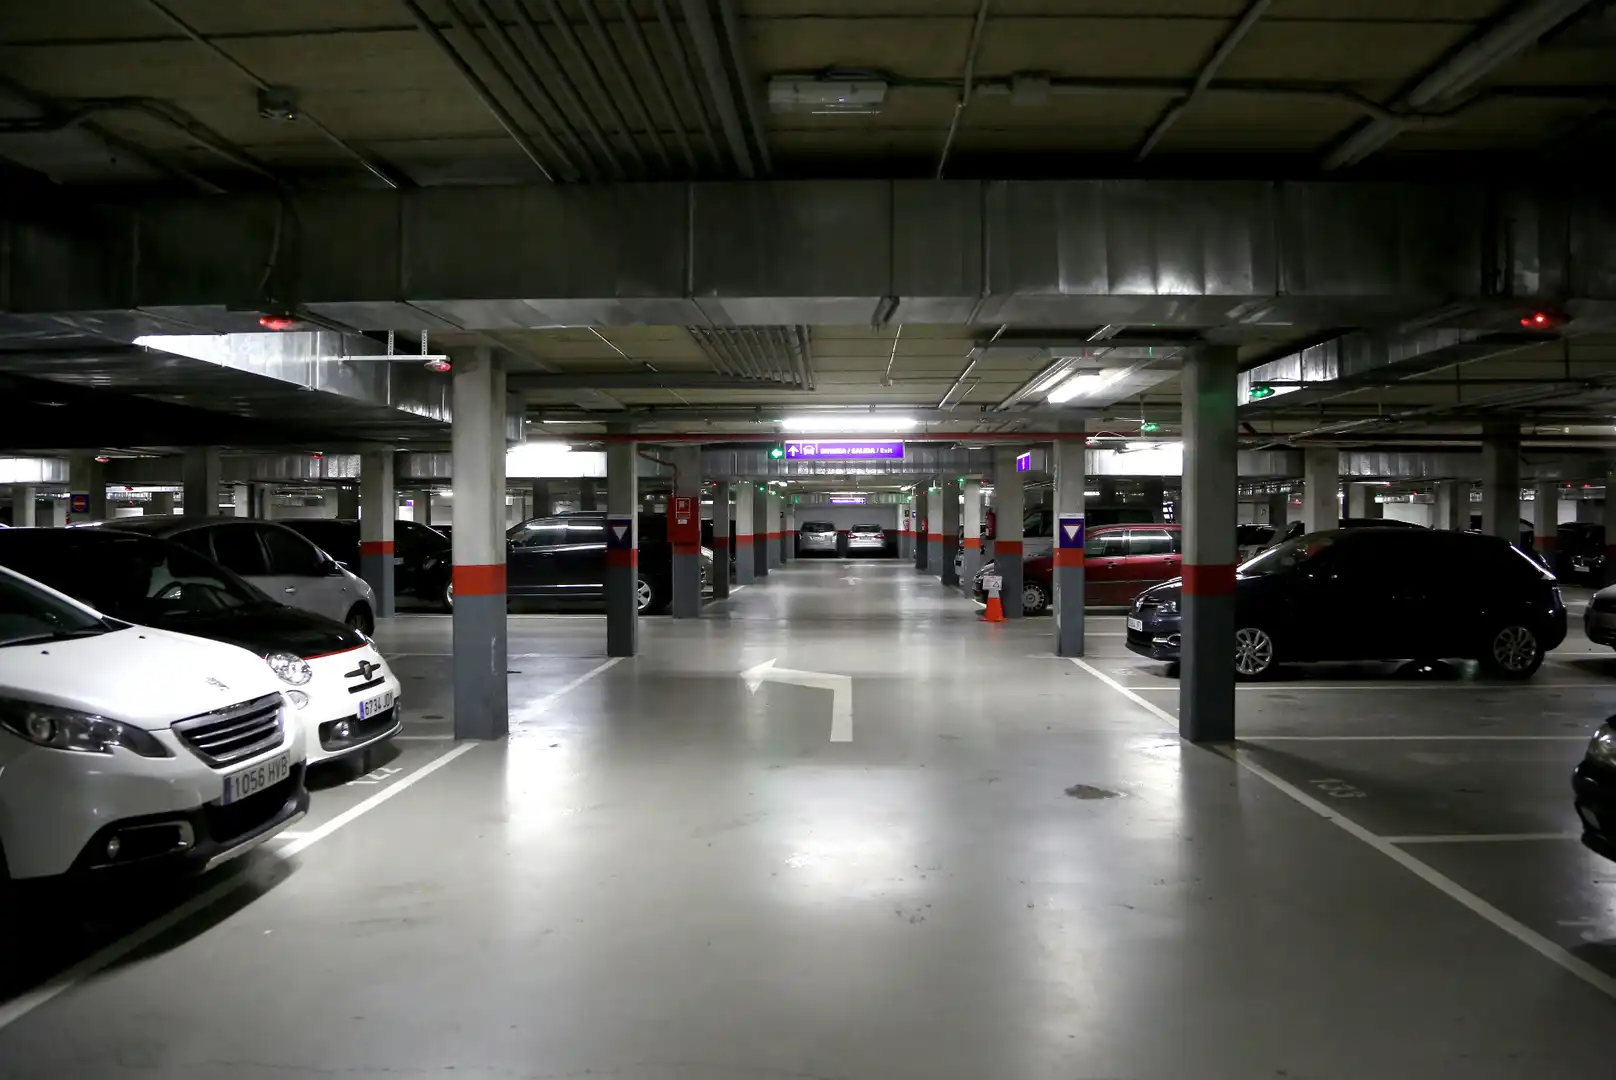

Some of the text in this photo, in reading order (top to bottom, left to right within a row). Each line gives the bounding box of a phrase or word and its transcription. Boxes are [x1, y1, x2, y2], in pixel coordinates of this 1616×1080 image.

[365, 697, 381, 716] 6734
[235, 756, 288, 798] 1056 HVB
